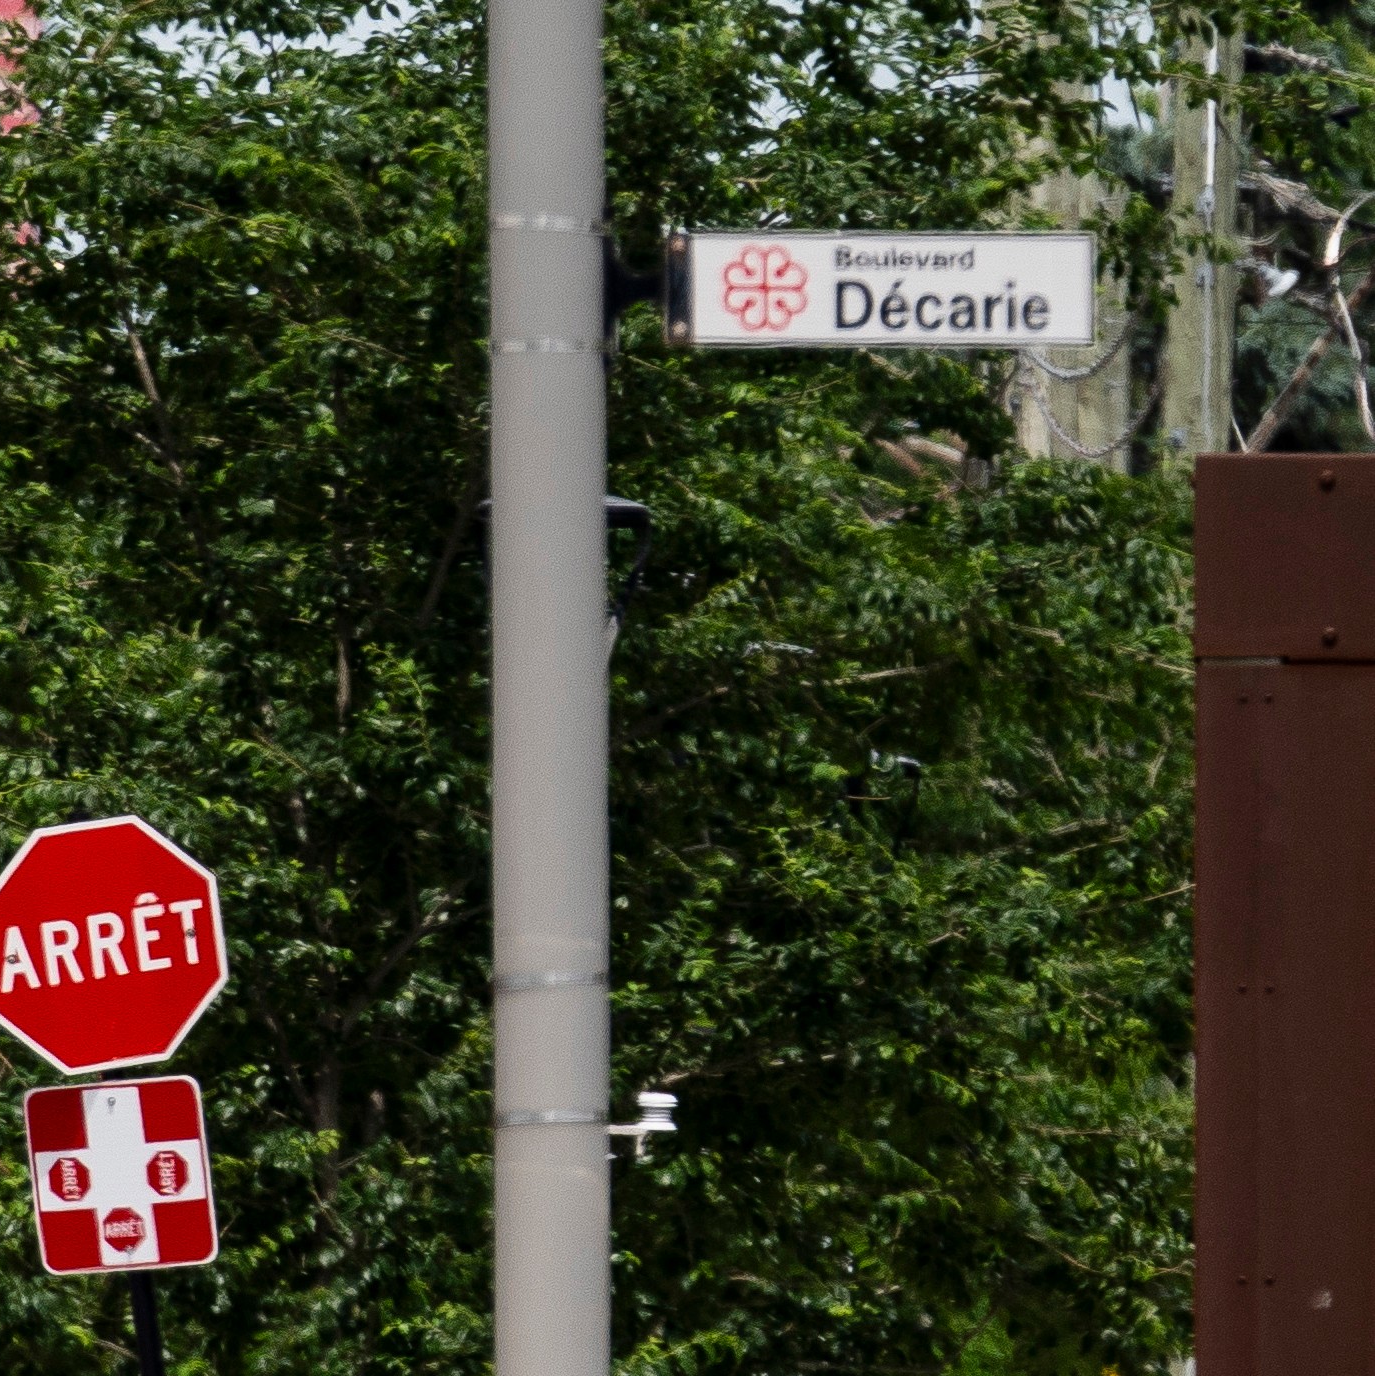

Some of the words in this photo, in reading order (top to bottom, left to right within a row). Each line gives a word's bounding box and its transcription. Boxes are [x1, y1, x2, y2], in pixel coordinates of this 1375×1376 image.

[834, 244, 975, 270] Boulevard
[835, 278, 1050, 331] Décarie
[0, 892, 203, 993] ARRÊT
